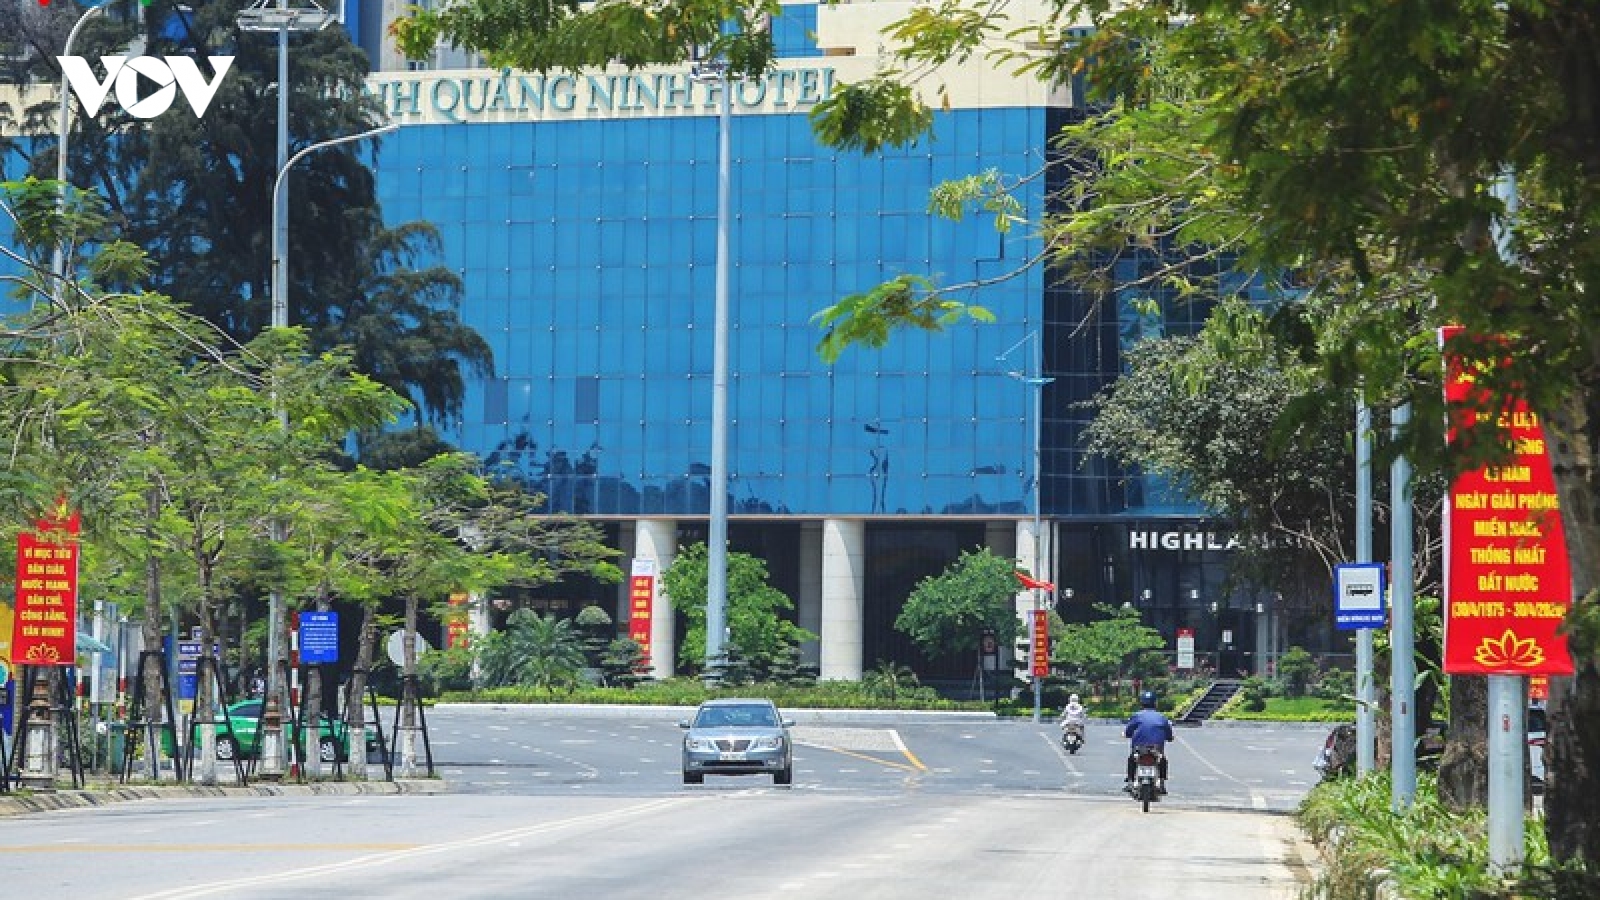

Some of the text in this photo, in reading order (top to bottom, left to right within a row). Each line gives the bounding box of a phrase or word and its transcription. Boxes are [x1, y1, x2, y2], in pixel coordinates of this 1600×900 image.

[586, 74, 695, 110] NINH
[1455, 491, 1488, 509] NGÀY
[1491, 488, 1516, 509] GIẢI
